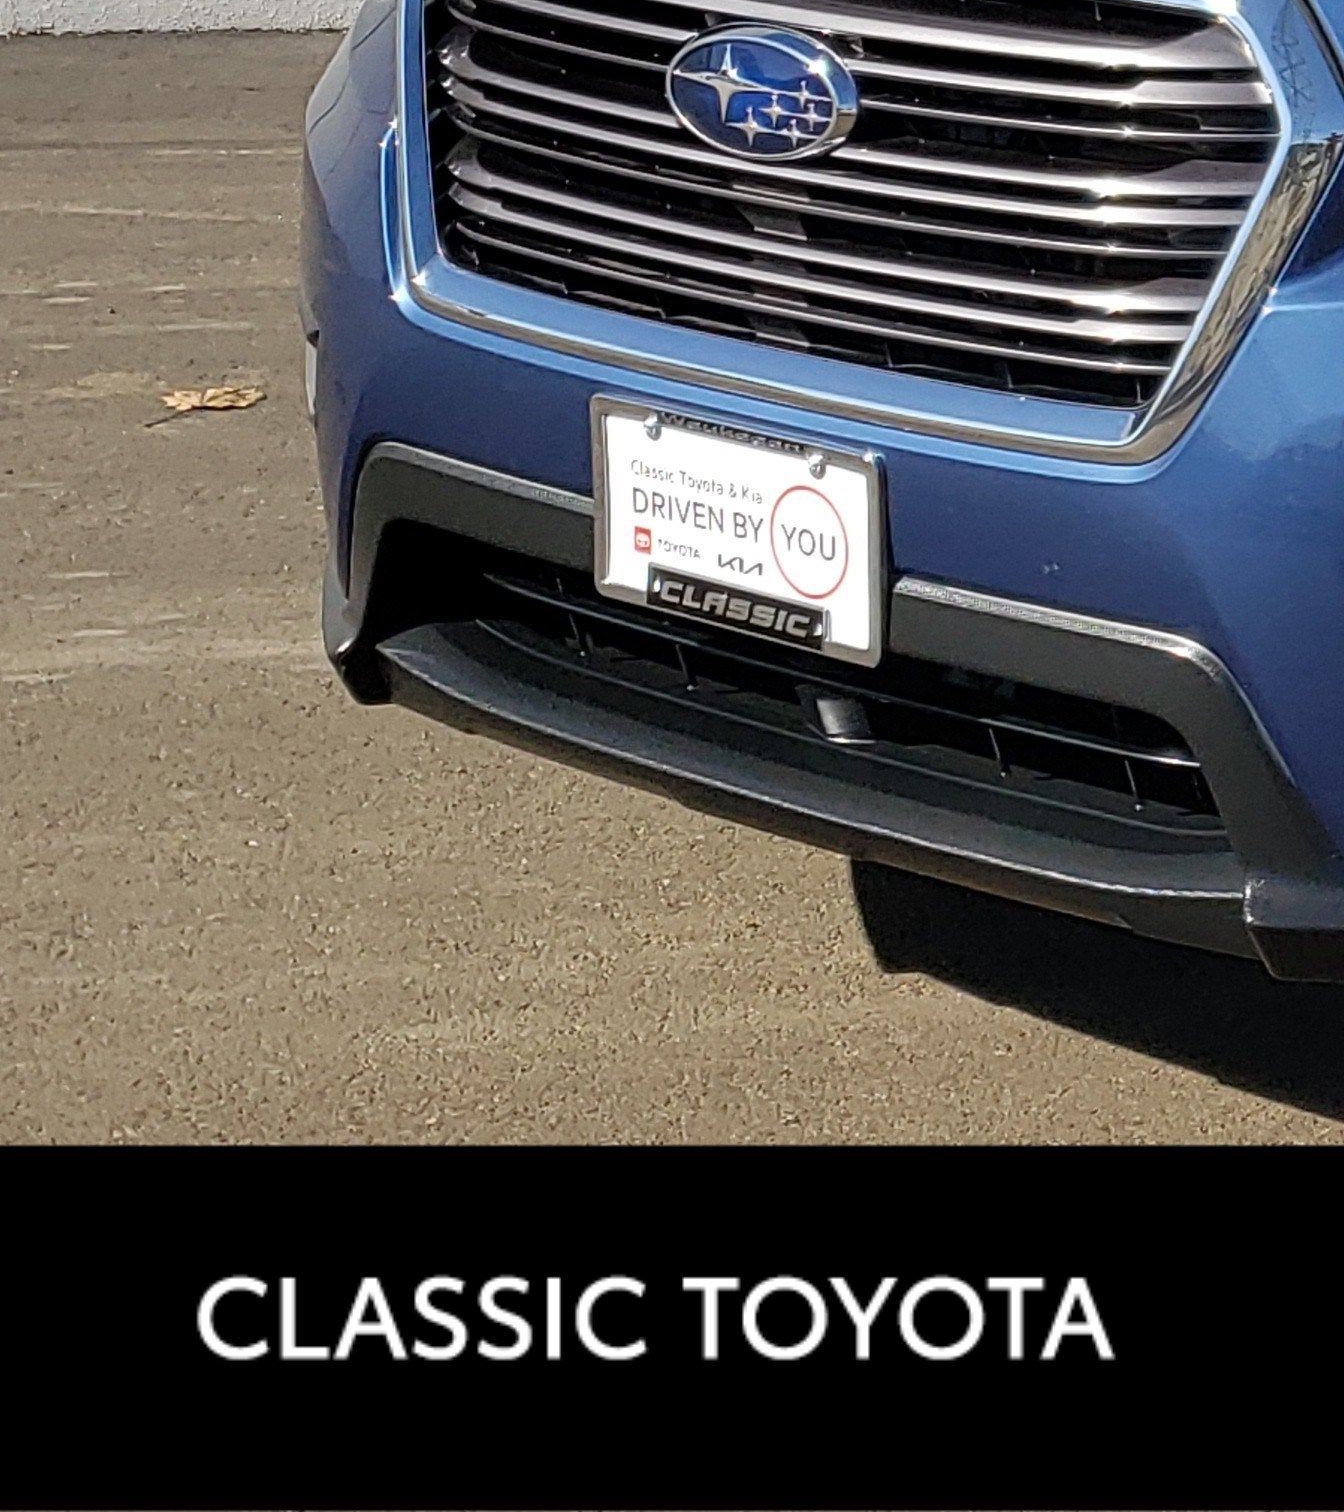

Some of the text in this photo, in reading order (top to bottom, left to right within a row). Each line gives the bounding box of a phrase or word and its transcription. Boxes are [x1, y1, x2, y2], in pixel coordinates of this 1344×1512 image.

[631, 460, 674, 484] Classic
[679, 470, 724, 495] Toyota
[741, 486, 763, 504] Kia
[632, 487, 763, 543] DRIVEN BY
[657, 538, 701, 558] TOYOTA
[781, 524, 836, 561] YOU
[659, 579, 812, 638] CLASSIC
